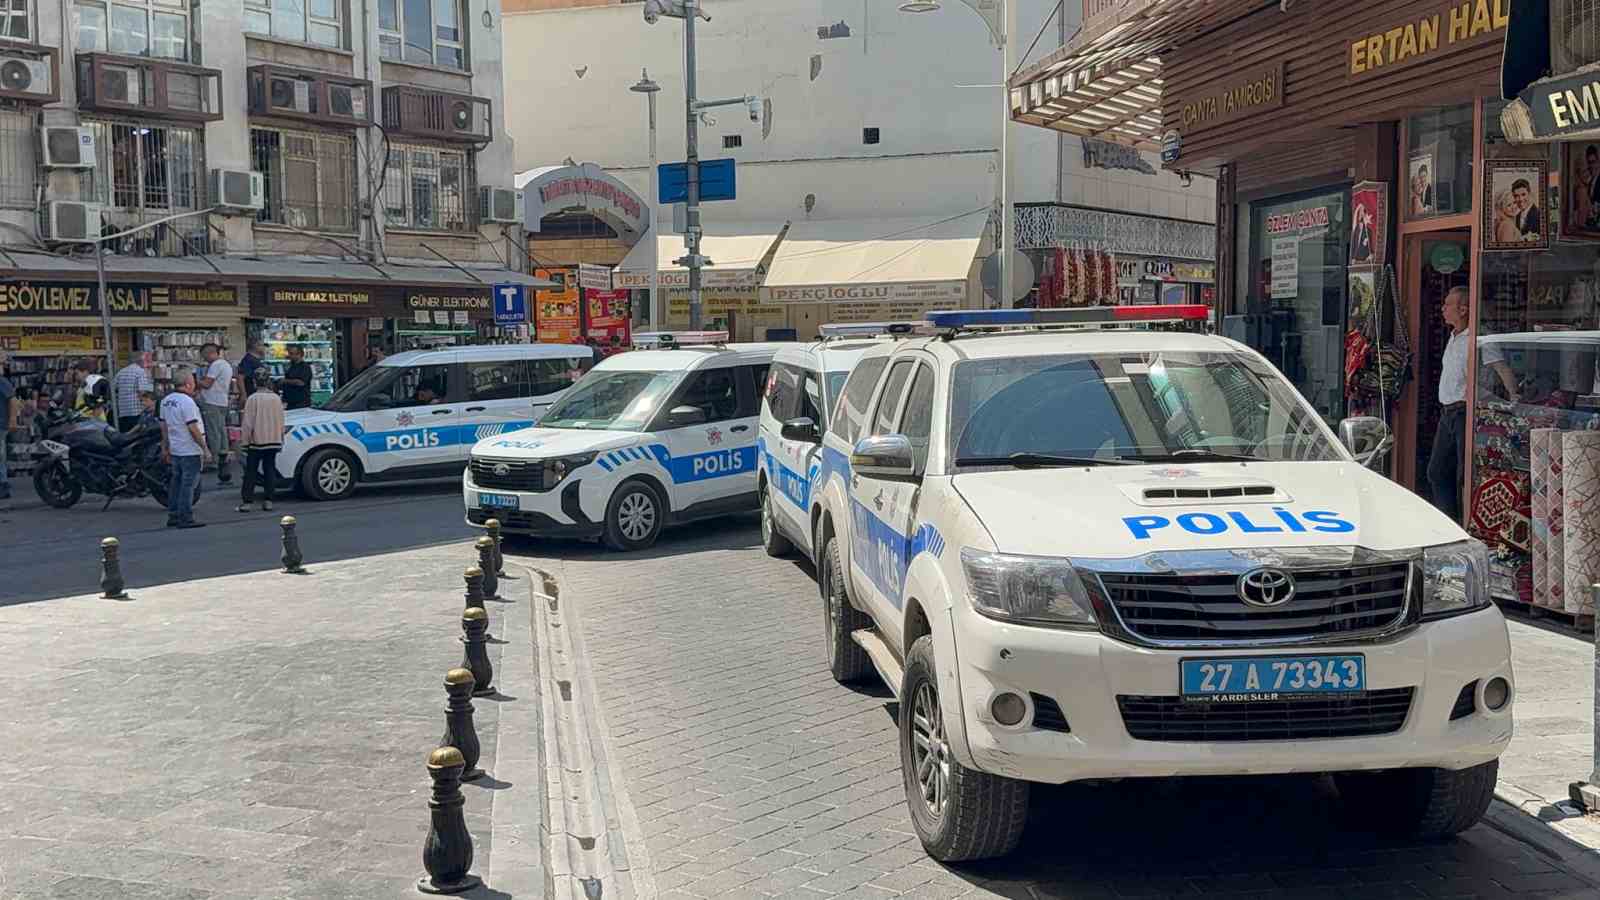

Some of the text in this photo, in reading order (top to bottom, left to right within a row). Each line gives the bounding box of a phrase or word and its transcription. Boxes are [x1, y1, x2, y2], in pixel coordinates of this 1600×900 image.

[1351, 14, 1440, 75] ERTAN
[1184, 96, 1217, 128] ÇANTA
[8, 282, 91, 311] SÖYLEMEZ
[274, 291, 369, 304] BİRYILMAZ İLETİŞİM
[410, 294, 440, 307] GÜNER
[500, 287, 517, 311] T
[386, 429, 440, 449] POLİS
[693, 449, 743, 475] POLİS
[1121, 507, 1355, 540] POLİS
[1200, 660, 1359, 691] 27 A 73343
